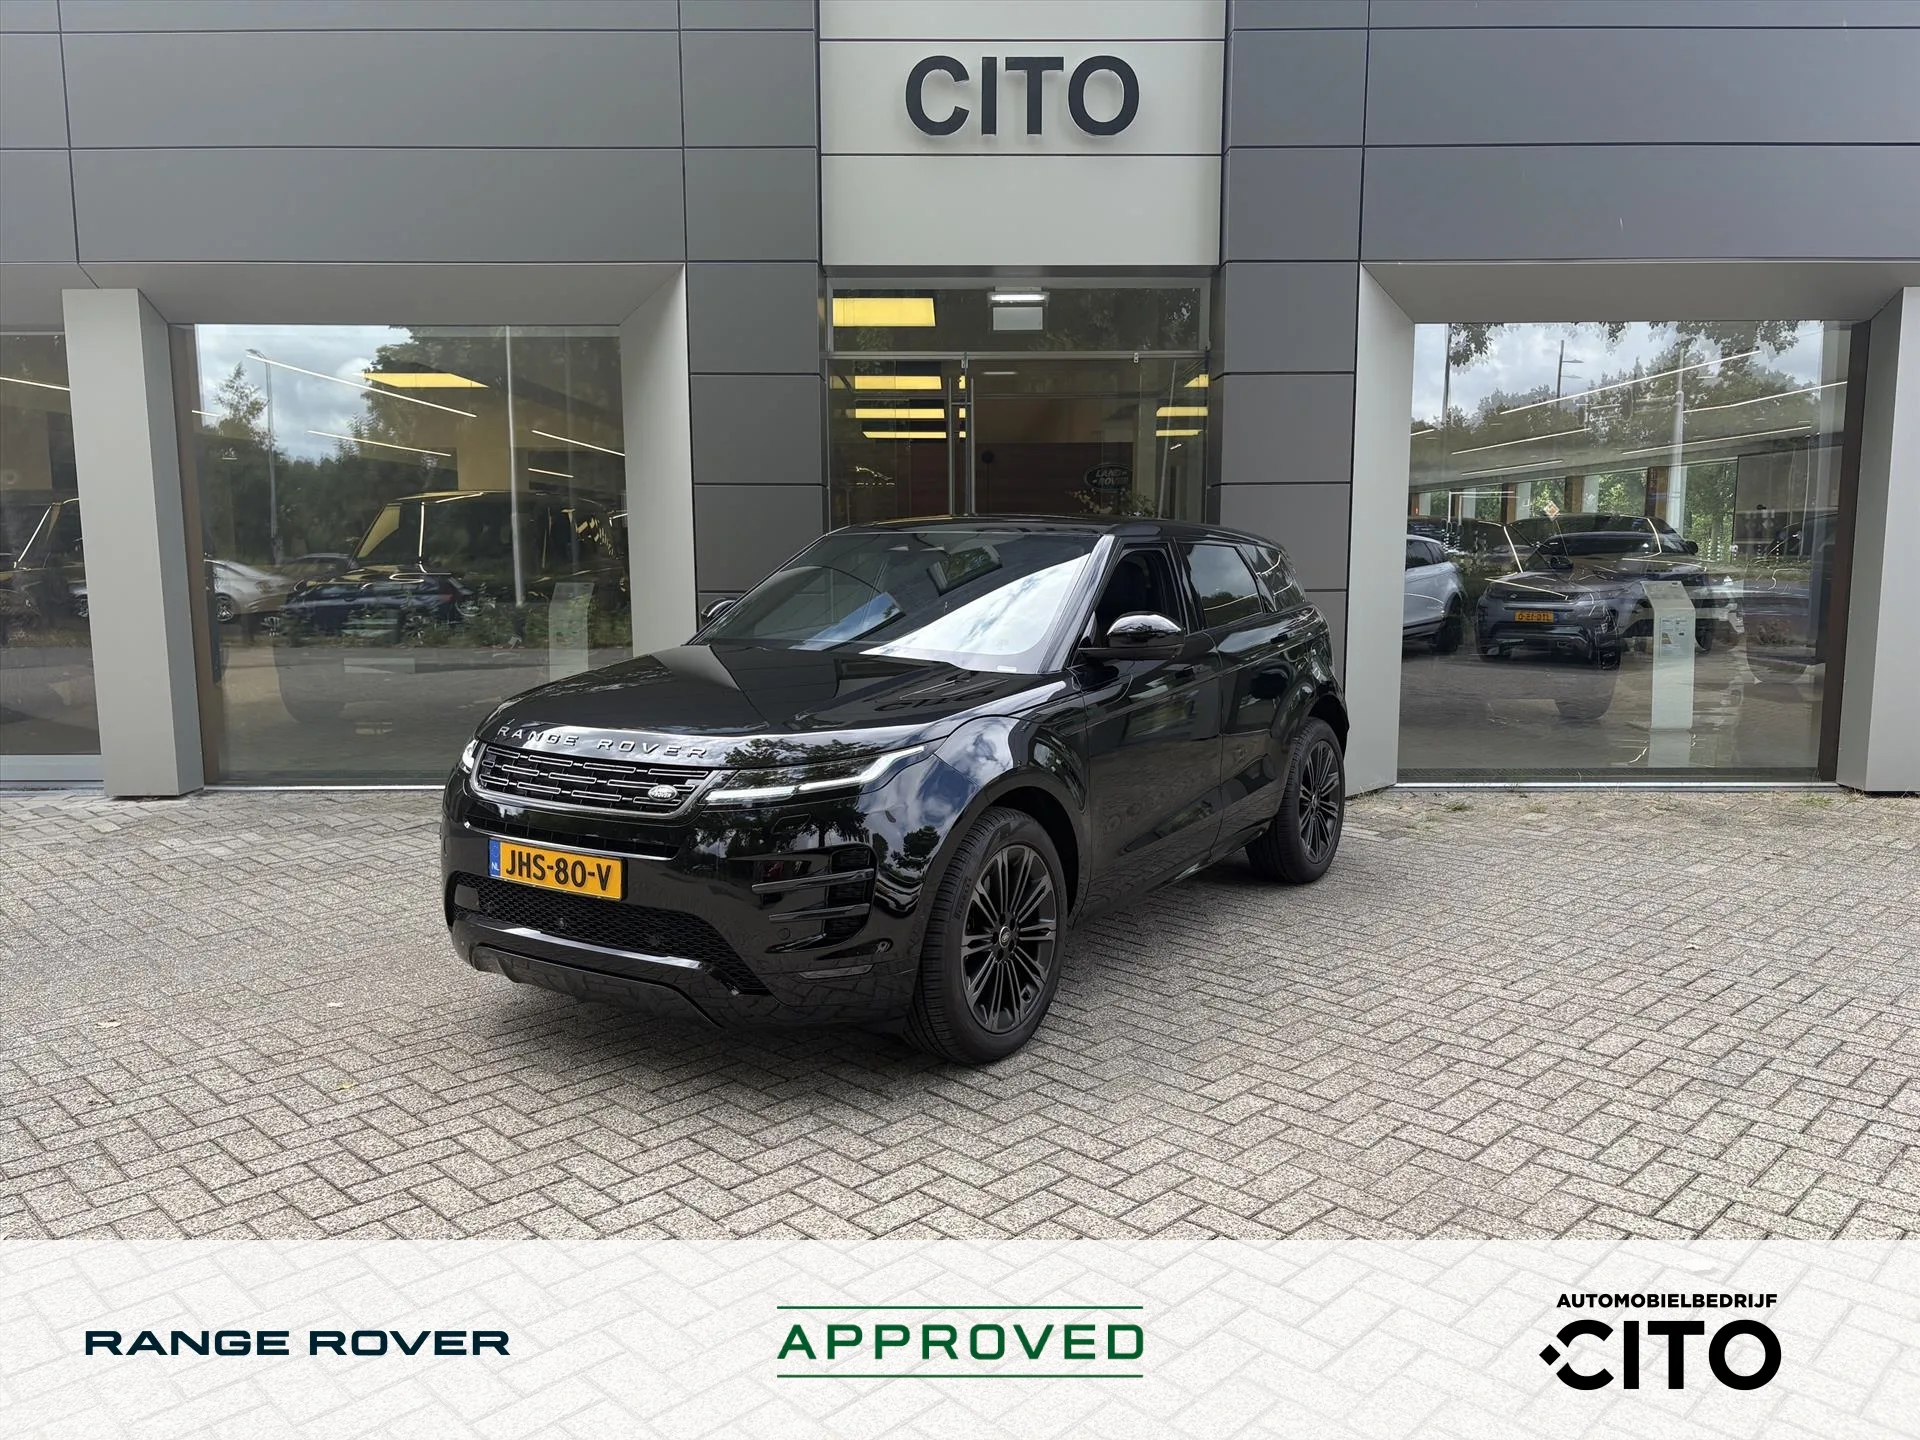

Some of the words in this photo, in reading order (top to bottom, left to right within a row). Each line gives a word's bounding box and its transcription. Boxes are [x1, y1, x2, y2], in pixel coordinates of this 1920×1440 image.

[905, 55, 1140, 137] CITO
[496, 726, 580, 747] RANGE
[596, 738, 709, 759] ROVER
[491, 861, 501, 872] NL
[505, 849, 612, 892] JHS-80-V
